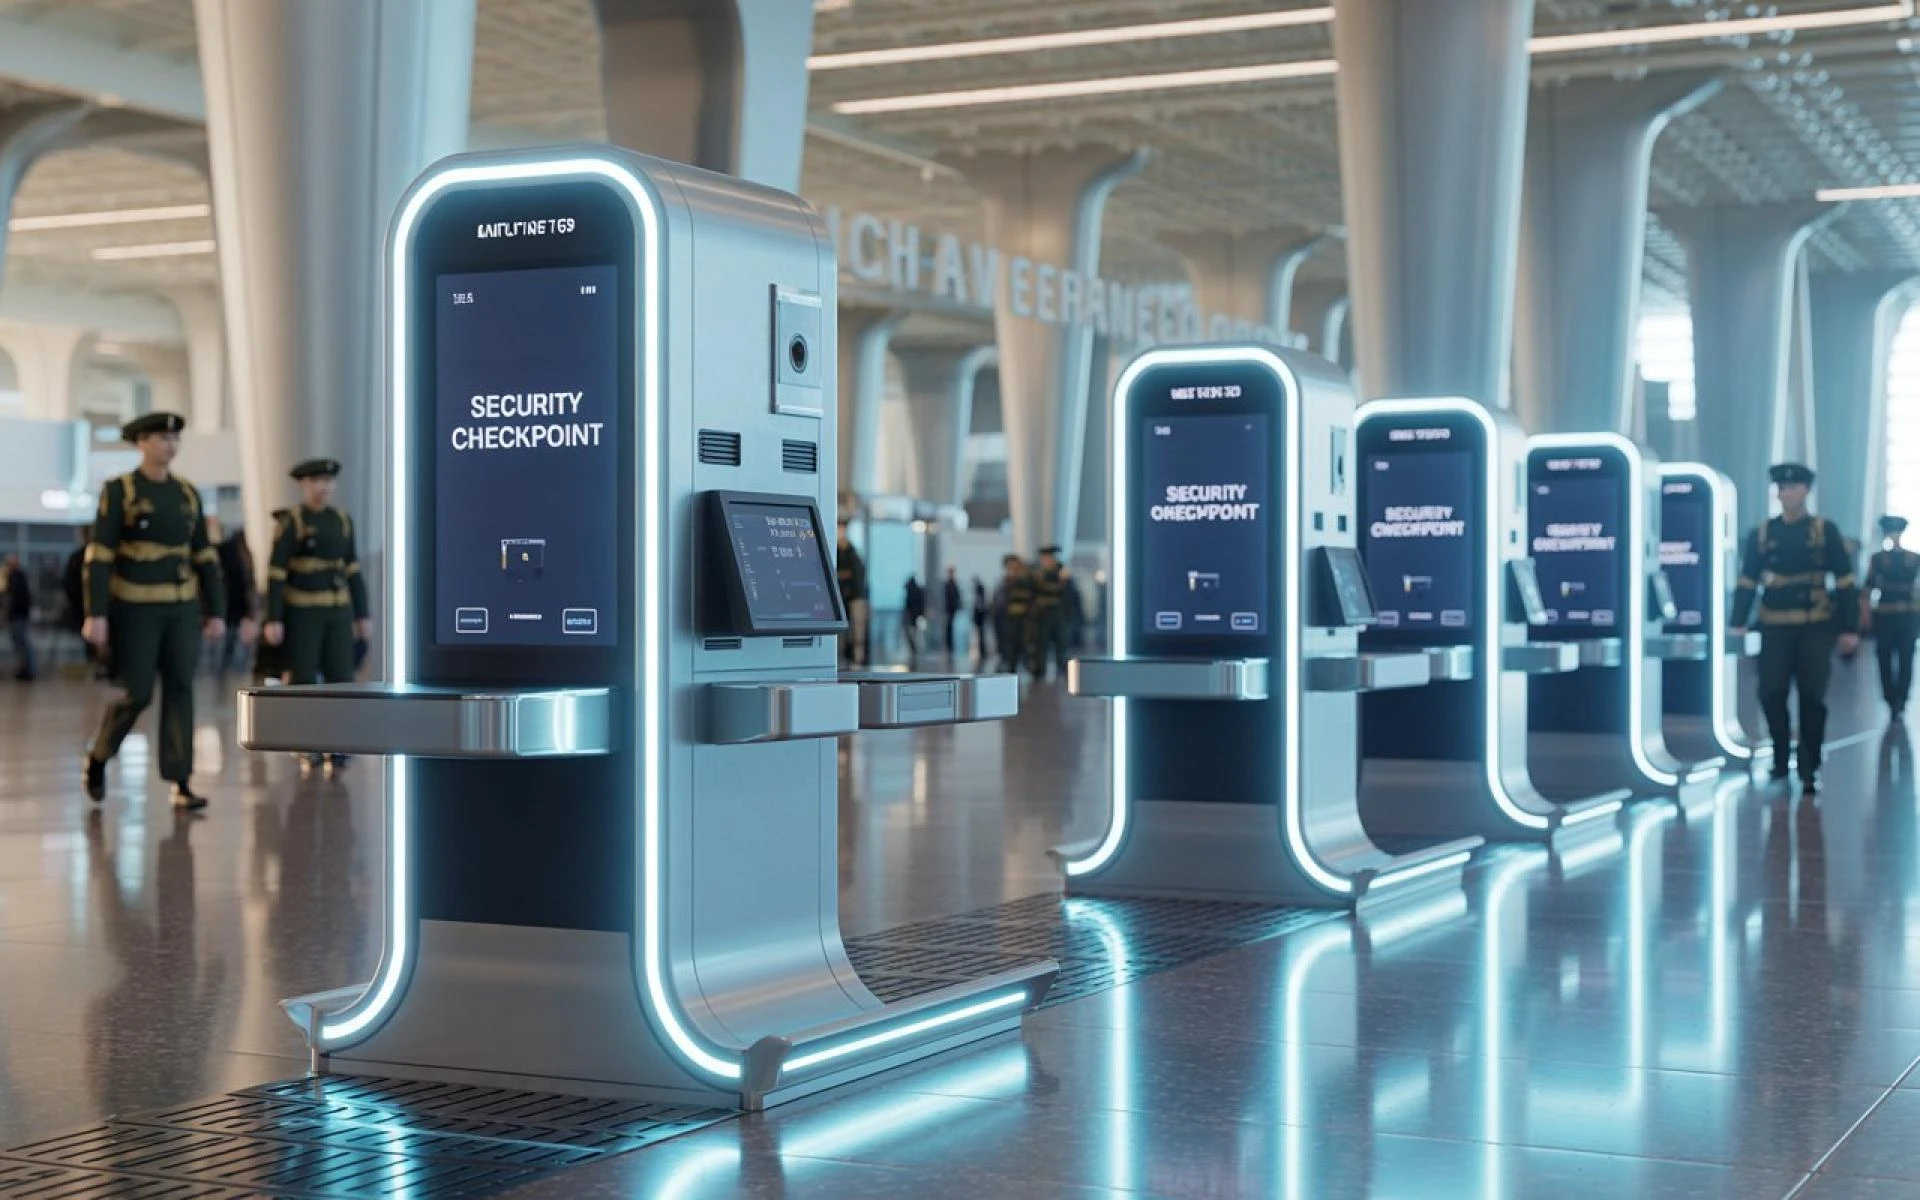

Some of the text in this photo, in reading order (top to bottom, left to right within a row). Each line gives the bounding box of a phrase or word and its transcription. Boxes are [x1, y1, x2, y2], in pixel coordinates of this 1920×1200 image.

[470, 391, 583, 419] SECURITY
[452, 422, 604, 450] CHECKPOINT
[1165, 483, 1248, 503] SECURITY
